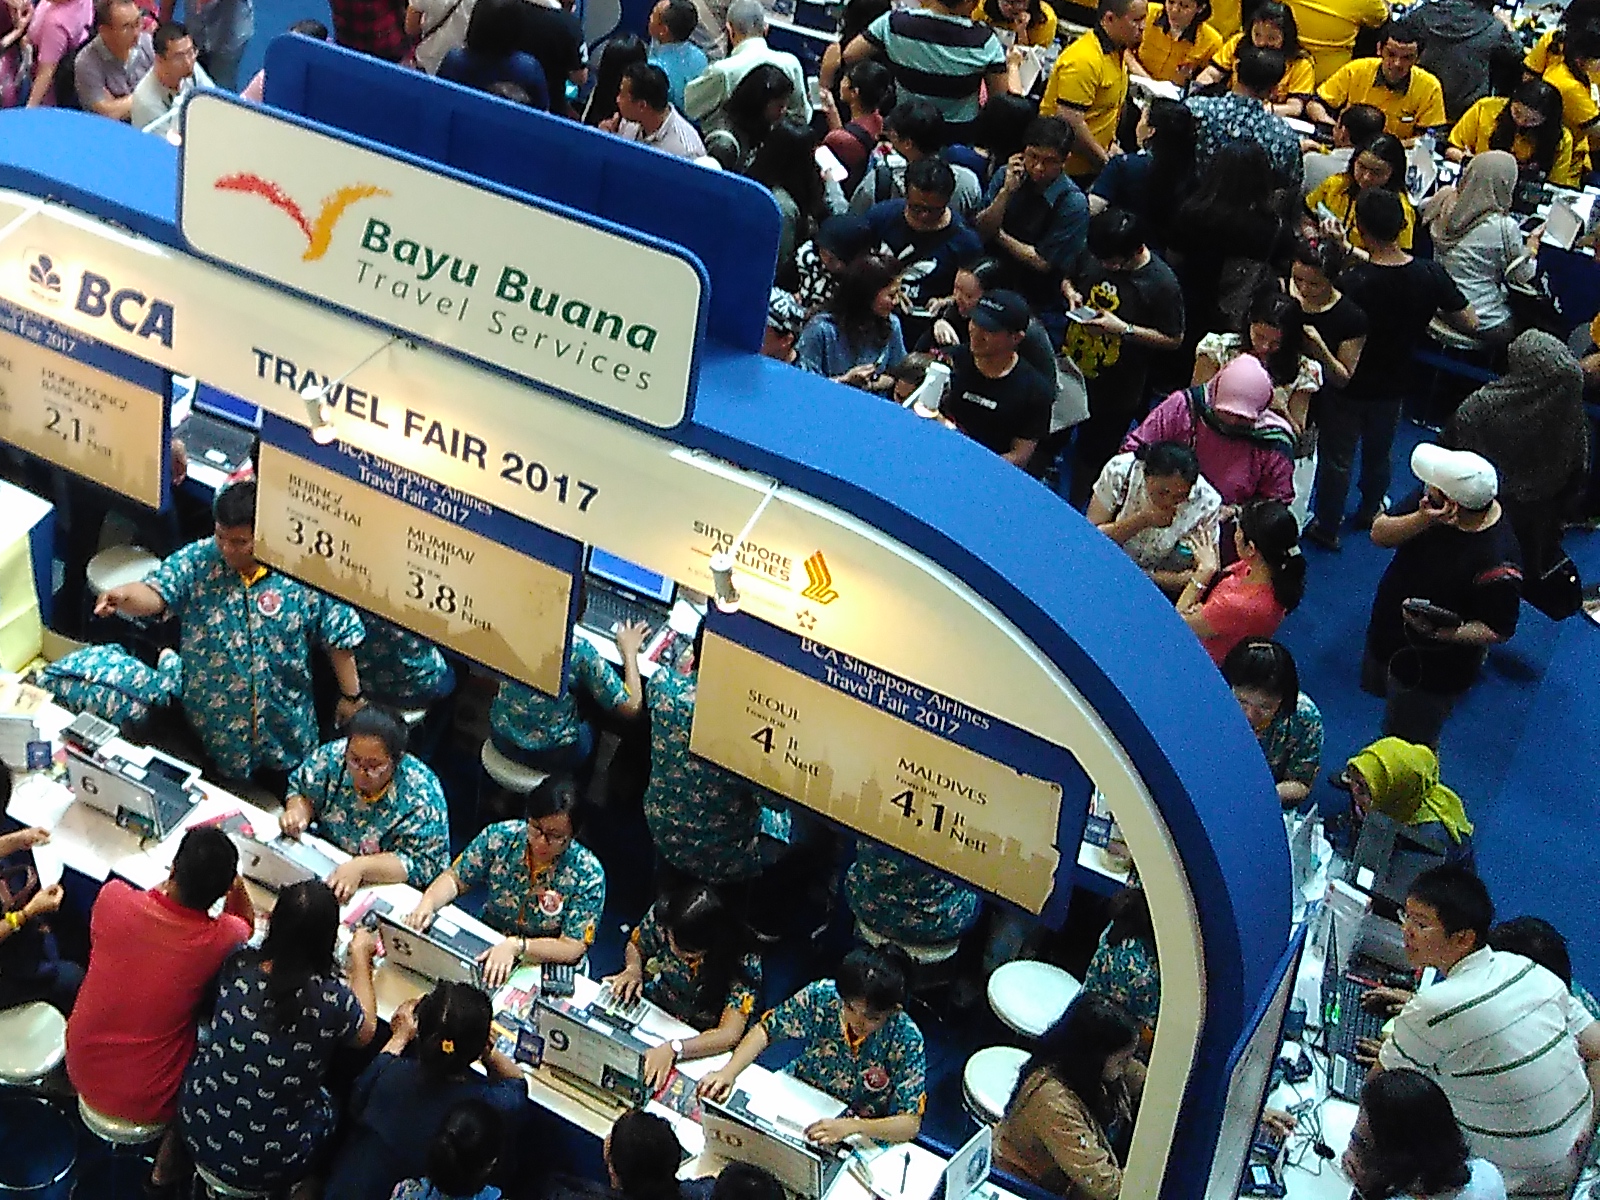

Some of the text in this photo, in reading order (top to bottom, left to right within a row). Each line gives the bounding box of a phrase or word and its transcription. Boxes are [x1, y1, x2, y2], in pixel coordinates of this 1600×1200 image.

[74, 269, 176, 351] BCA
[358, 216, 660, 355] Bayu Buana
[44, 329, 77, 353] 2017
[356, 258, 655, 393] Travel Services
[43, 406, 83, 444] 2,1
[402, 407, 490, 472] FAIR
[500, 450, 602, 515] 2017
[287, 485, 363, 528] SHANGHAI
[357, 463, 471, 526] Travel Fair 2017
[286, 516, 335, 560] 3,8
[404, 568, 458, 616] 3,8
[747, 688, 802, 724] SEOUL
[800, 635, 991, 731] BCA Singapore Airlines
[823, 663, 962, 736] Travel Fair 2017
[750, 725, 777, 756] 4
[784, 749, 821, 779] Nett
[81, 775, 99, 796] 6
[897, 756, 989, 807] MALDIVES
[890, 788, 947, 834] 4,1
[949, 827, 989, 855] Nett
[392, 936, 413, 957] 8
[547, 1027, 572, 1055] 9
[710, 1125, 744, 1149] 10
